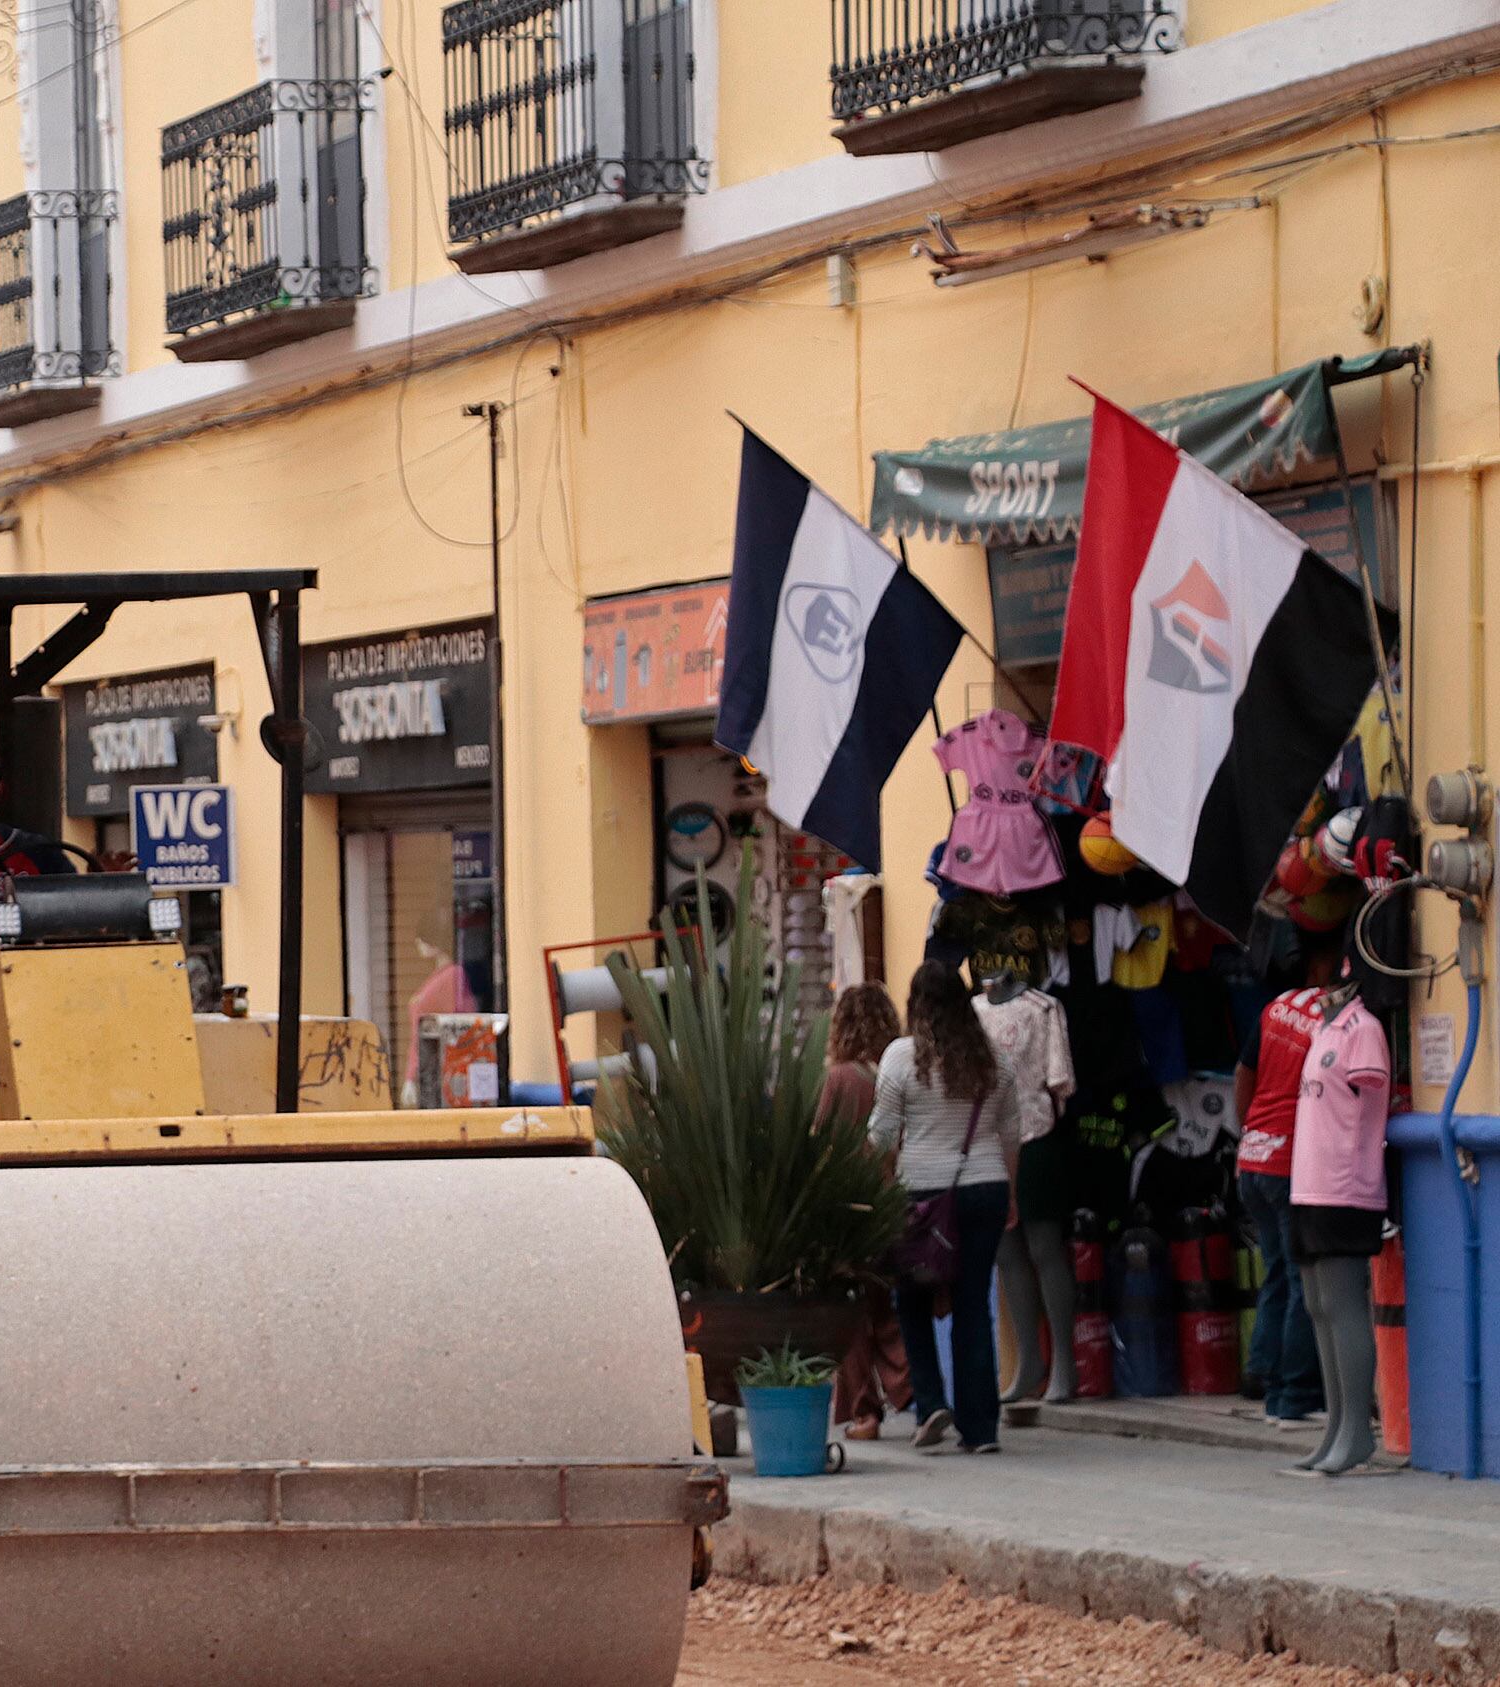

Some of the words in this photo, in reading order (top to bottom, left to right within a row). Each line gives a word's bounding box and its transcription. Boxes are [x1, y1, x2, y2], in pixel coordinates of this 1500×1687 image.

[964, 460, 1060, 518] SPORT
[327, 647, 366, 682] PLAZA
[367, 643, 385, 677] DE
[386, 629, 486, 673] IMPORTACIONES
[140, 790, 222, 840] WC
[146, 865, 220, 884] PUBLICOS
[156, 842, 210, 865] BAÑOS
